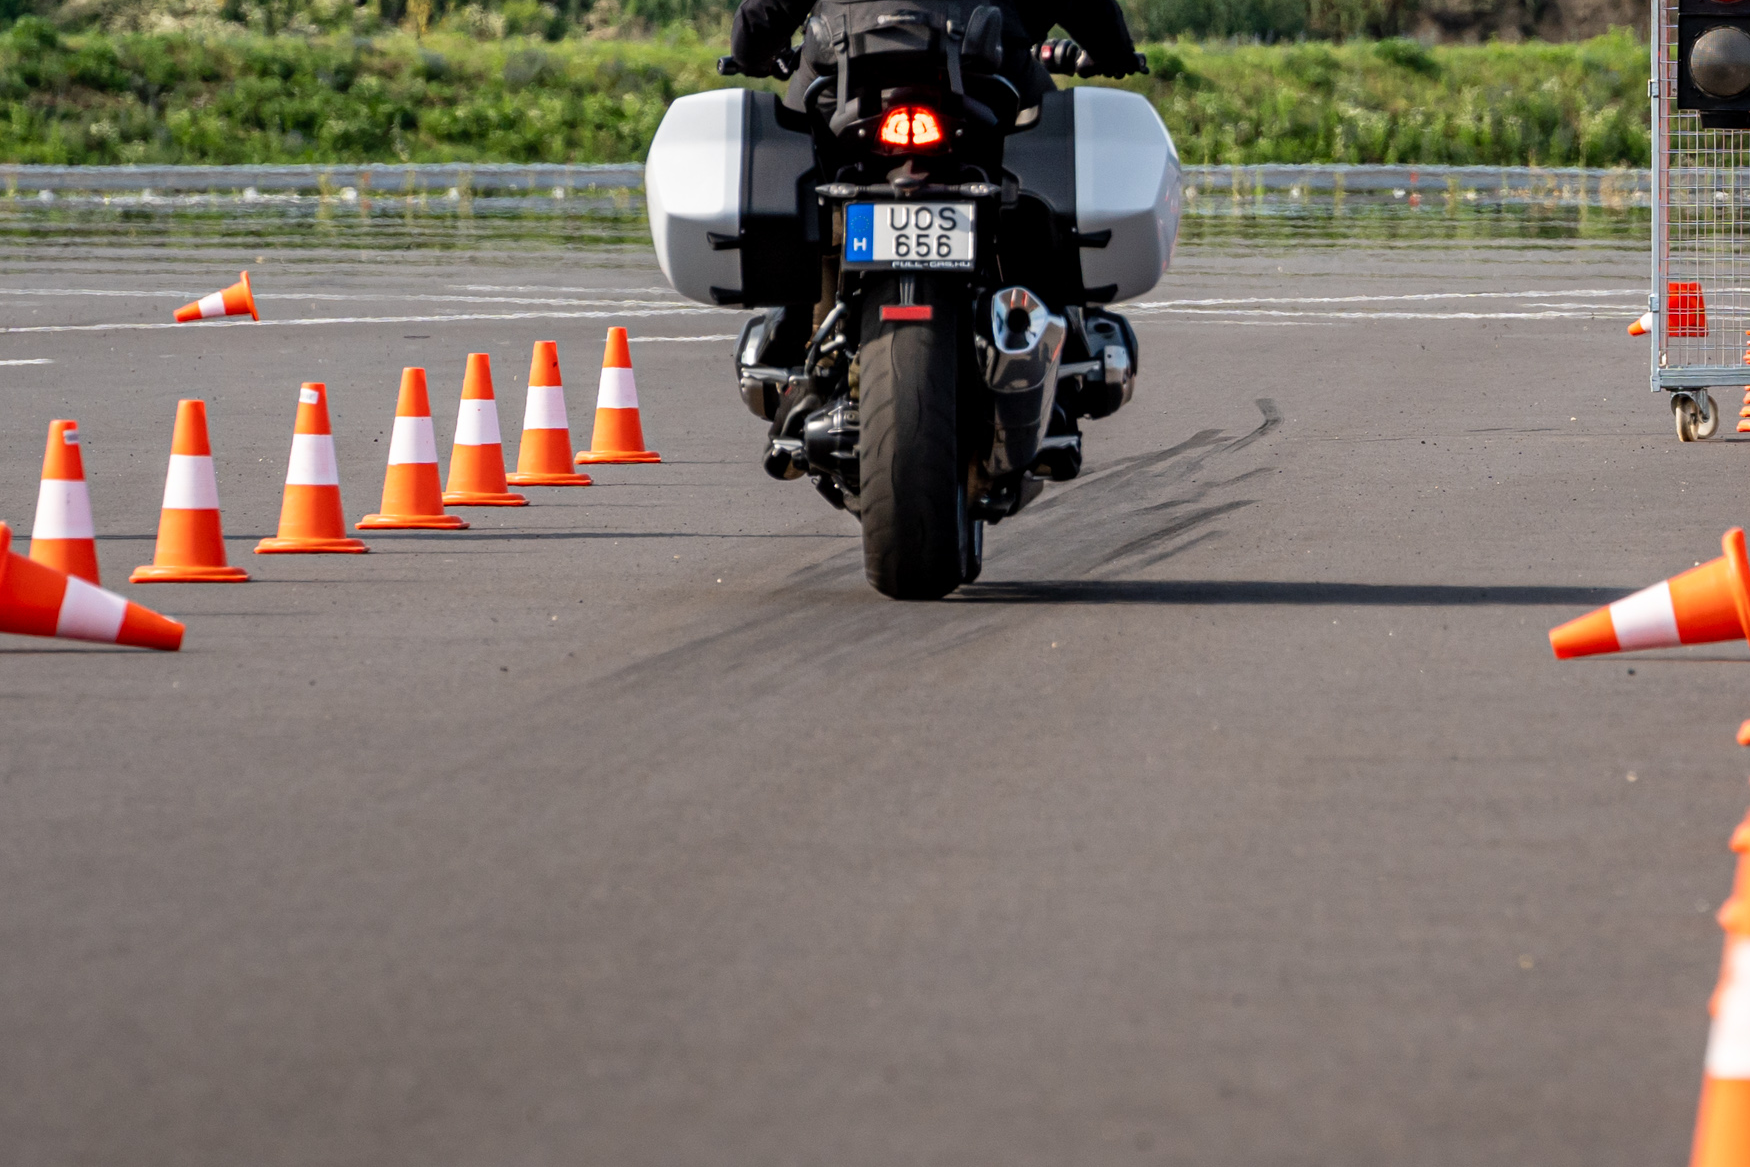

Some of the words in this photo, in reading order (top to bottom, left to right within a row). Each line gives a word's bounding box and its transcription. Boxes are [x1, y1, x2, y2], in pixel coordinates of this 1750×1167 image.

[888, 206, 957, 231] UOS
[853, 237, 867, 251] H
[894, 234, 952, 257] 656
